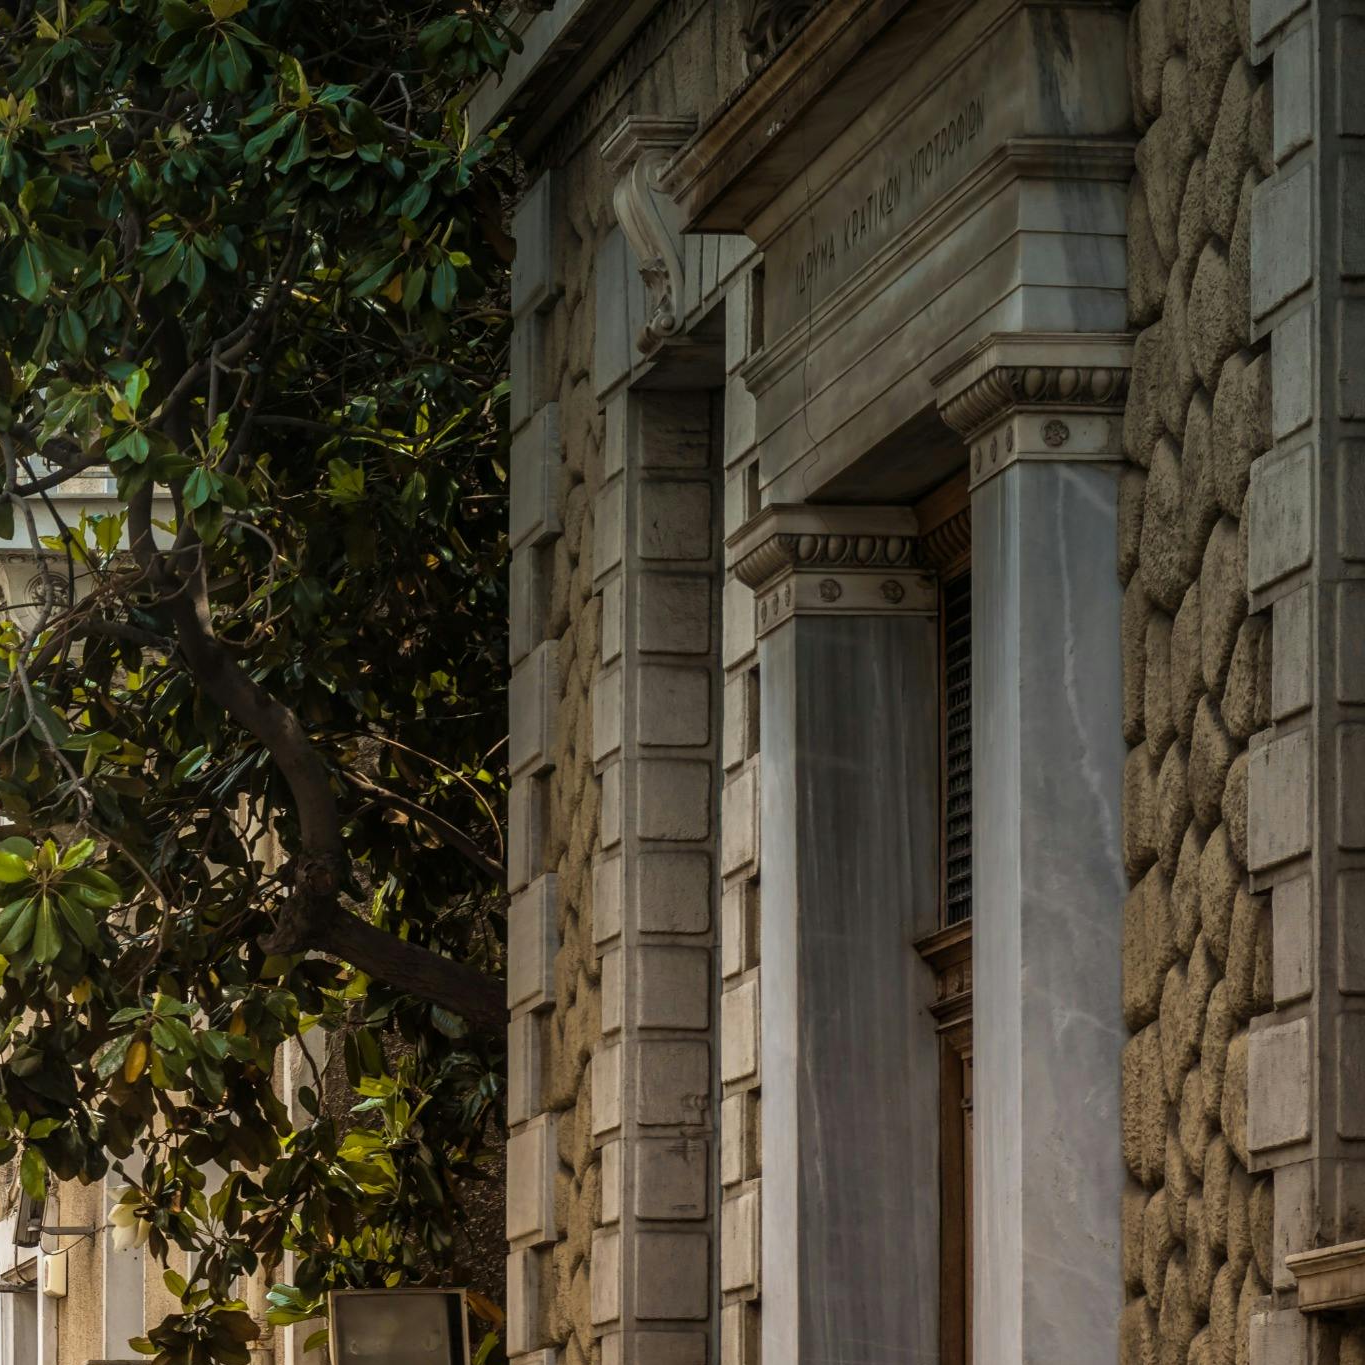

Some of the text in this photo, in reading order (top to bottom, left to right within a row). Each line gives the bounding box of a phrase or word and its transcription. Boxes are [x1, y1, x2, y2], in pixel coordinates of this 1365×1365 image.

[796, 92, 985, 295] ΙΔΡΥΜΑ ΚΡΑΤΙΚΩΝ ΥΠΟΤΡΟΦΙΩΝ
